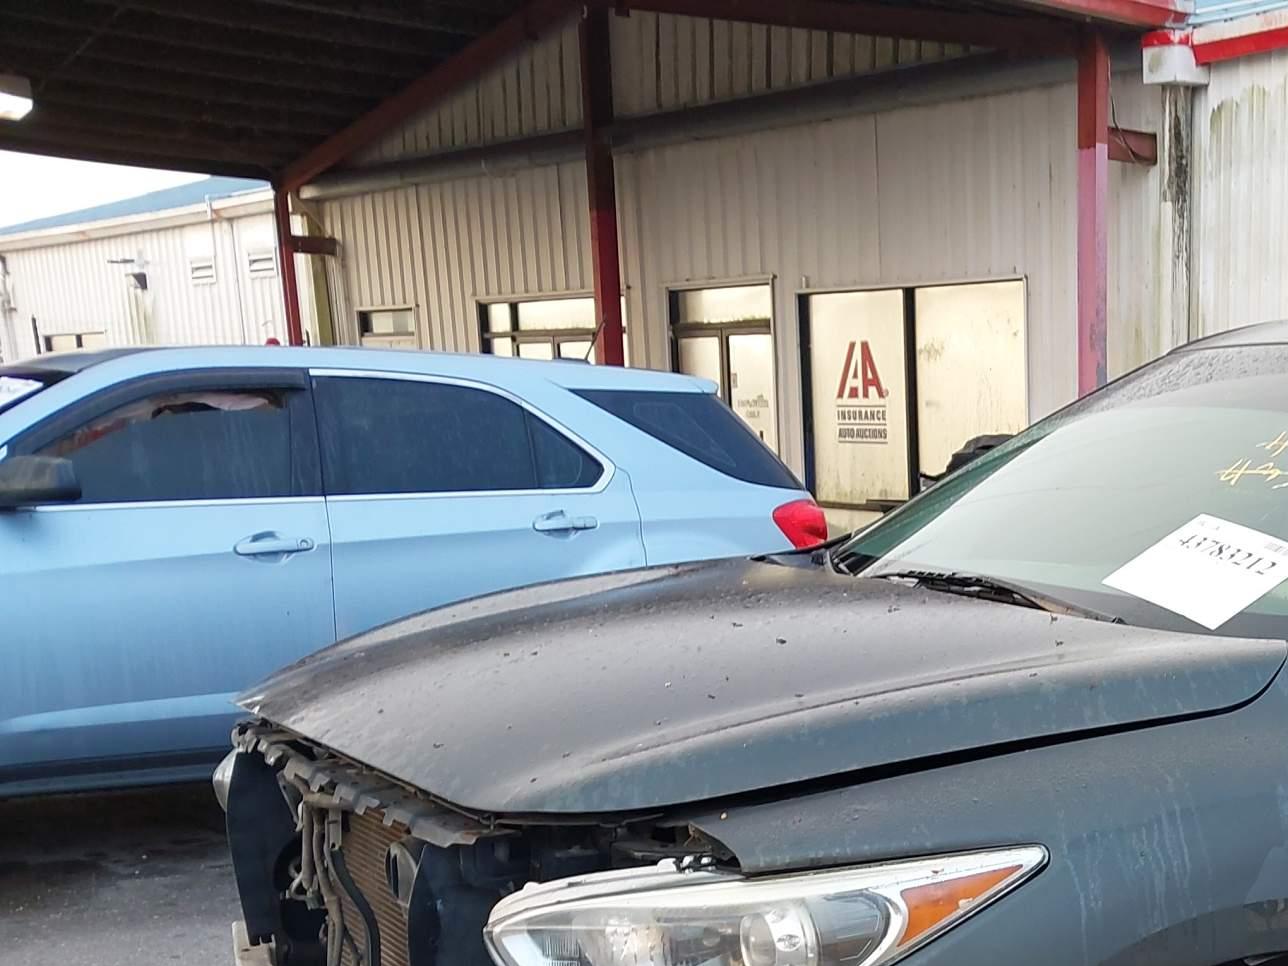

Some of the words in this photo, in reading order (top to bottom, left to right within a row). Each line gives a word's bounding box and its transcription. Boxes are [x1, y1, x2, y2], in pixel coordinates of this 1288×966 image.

[838, 410, 887, 421] INSURANCE
[838, 428, 855, 440] AUTO
[855, 428, 888, 440] AUCTIONS
[1179, 534, 1275, 576] 43783212
